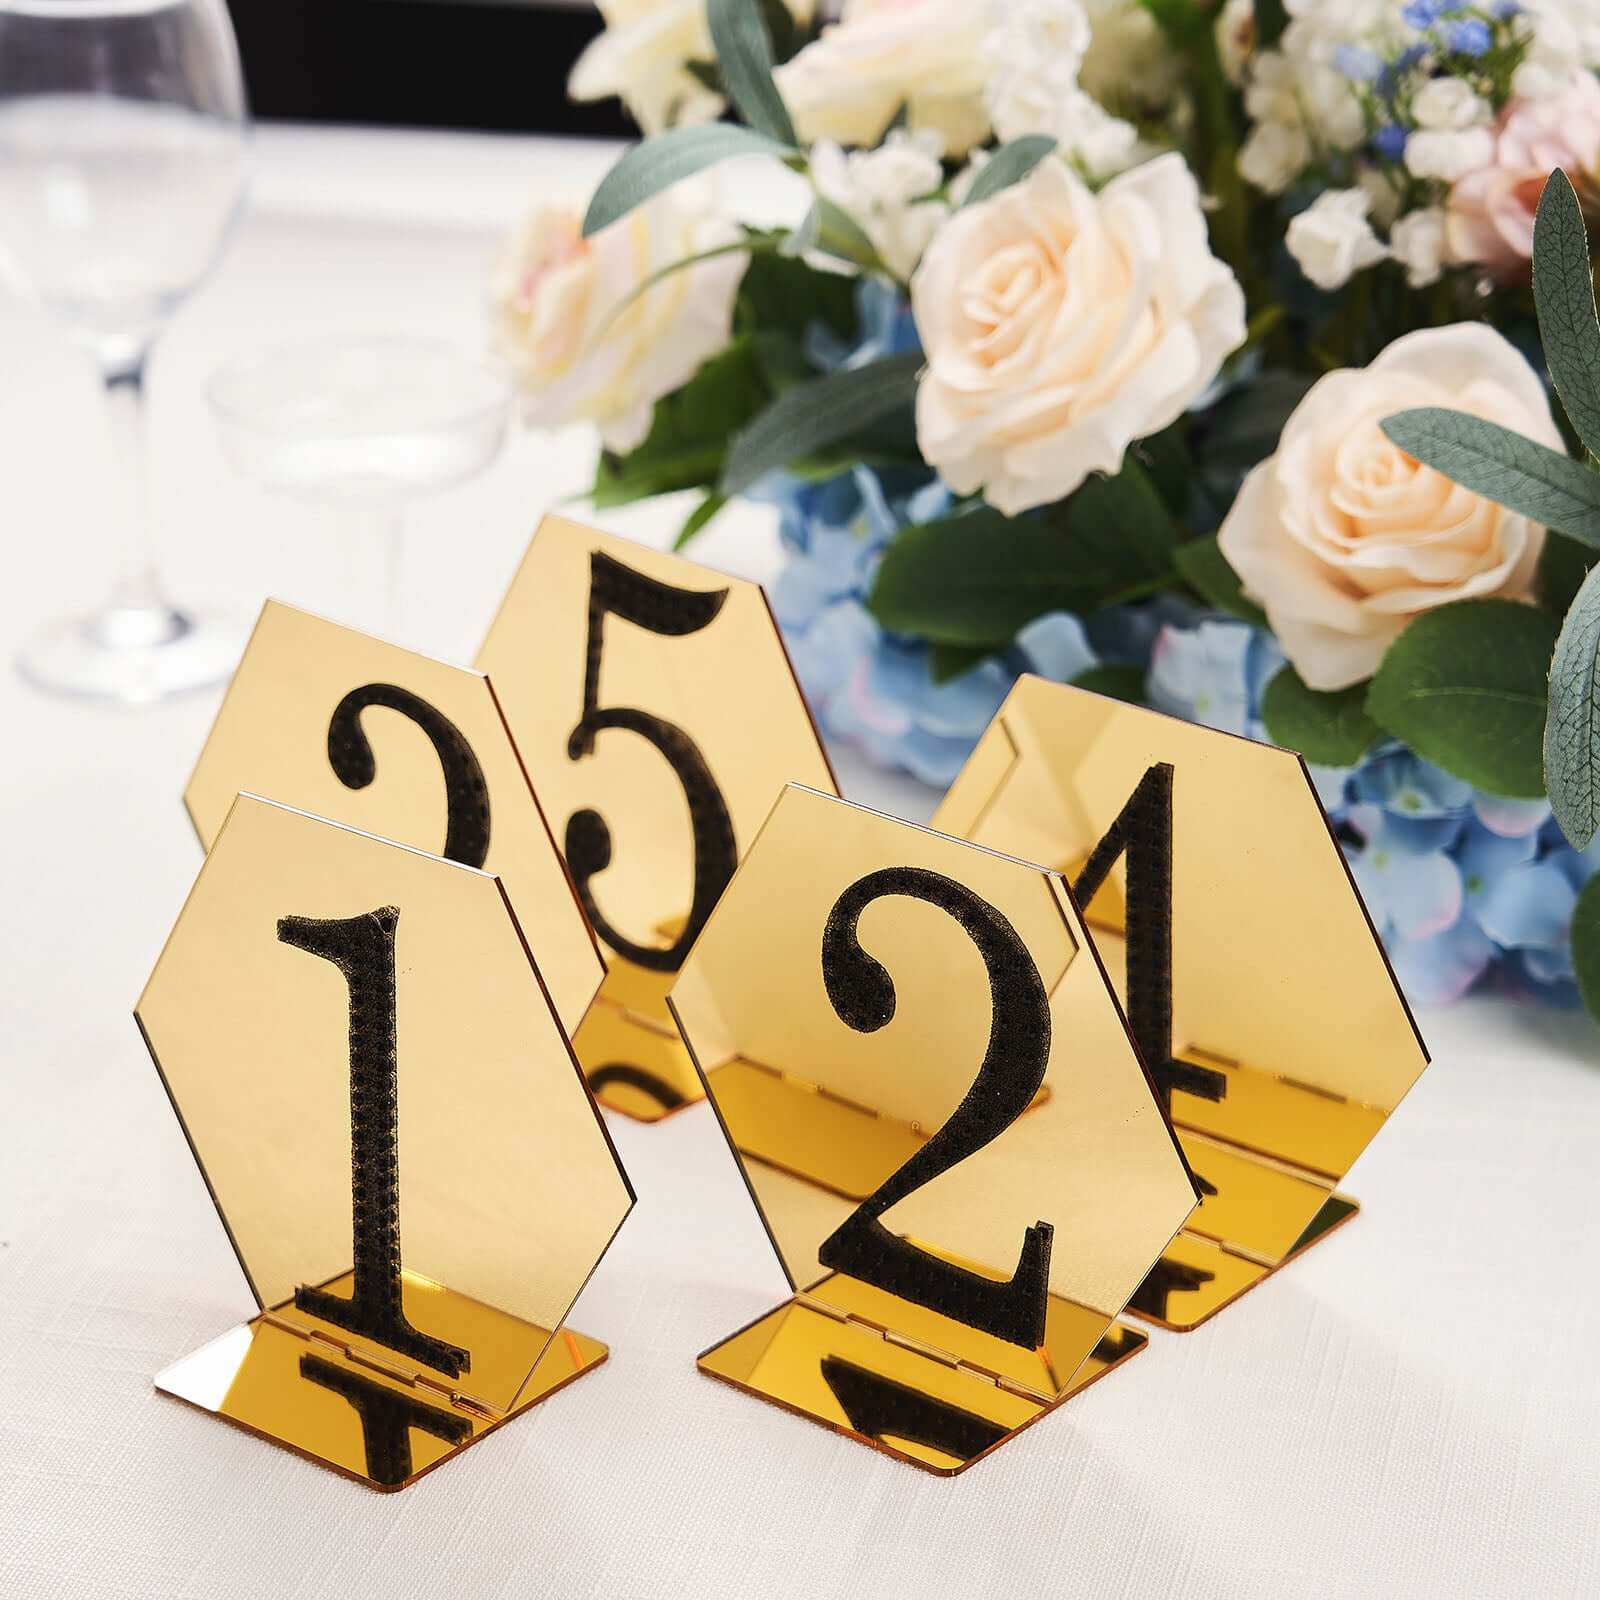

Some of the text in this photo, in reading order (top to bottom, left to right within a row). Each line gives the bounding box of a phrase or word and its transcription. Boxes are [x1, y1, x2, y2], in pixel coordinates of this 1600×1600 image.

[564, 550, 738, 972] 5
[1070, 761, 1227, 1117] 4
[276, 905, 471, 1380] 1
[818, 867, 1054, 1352] 2
